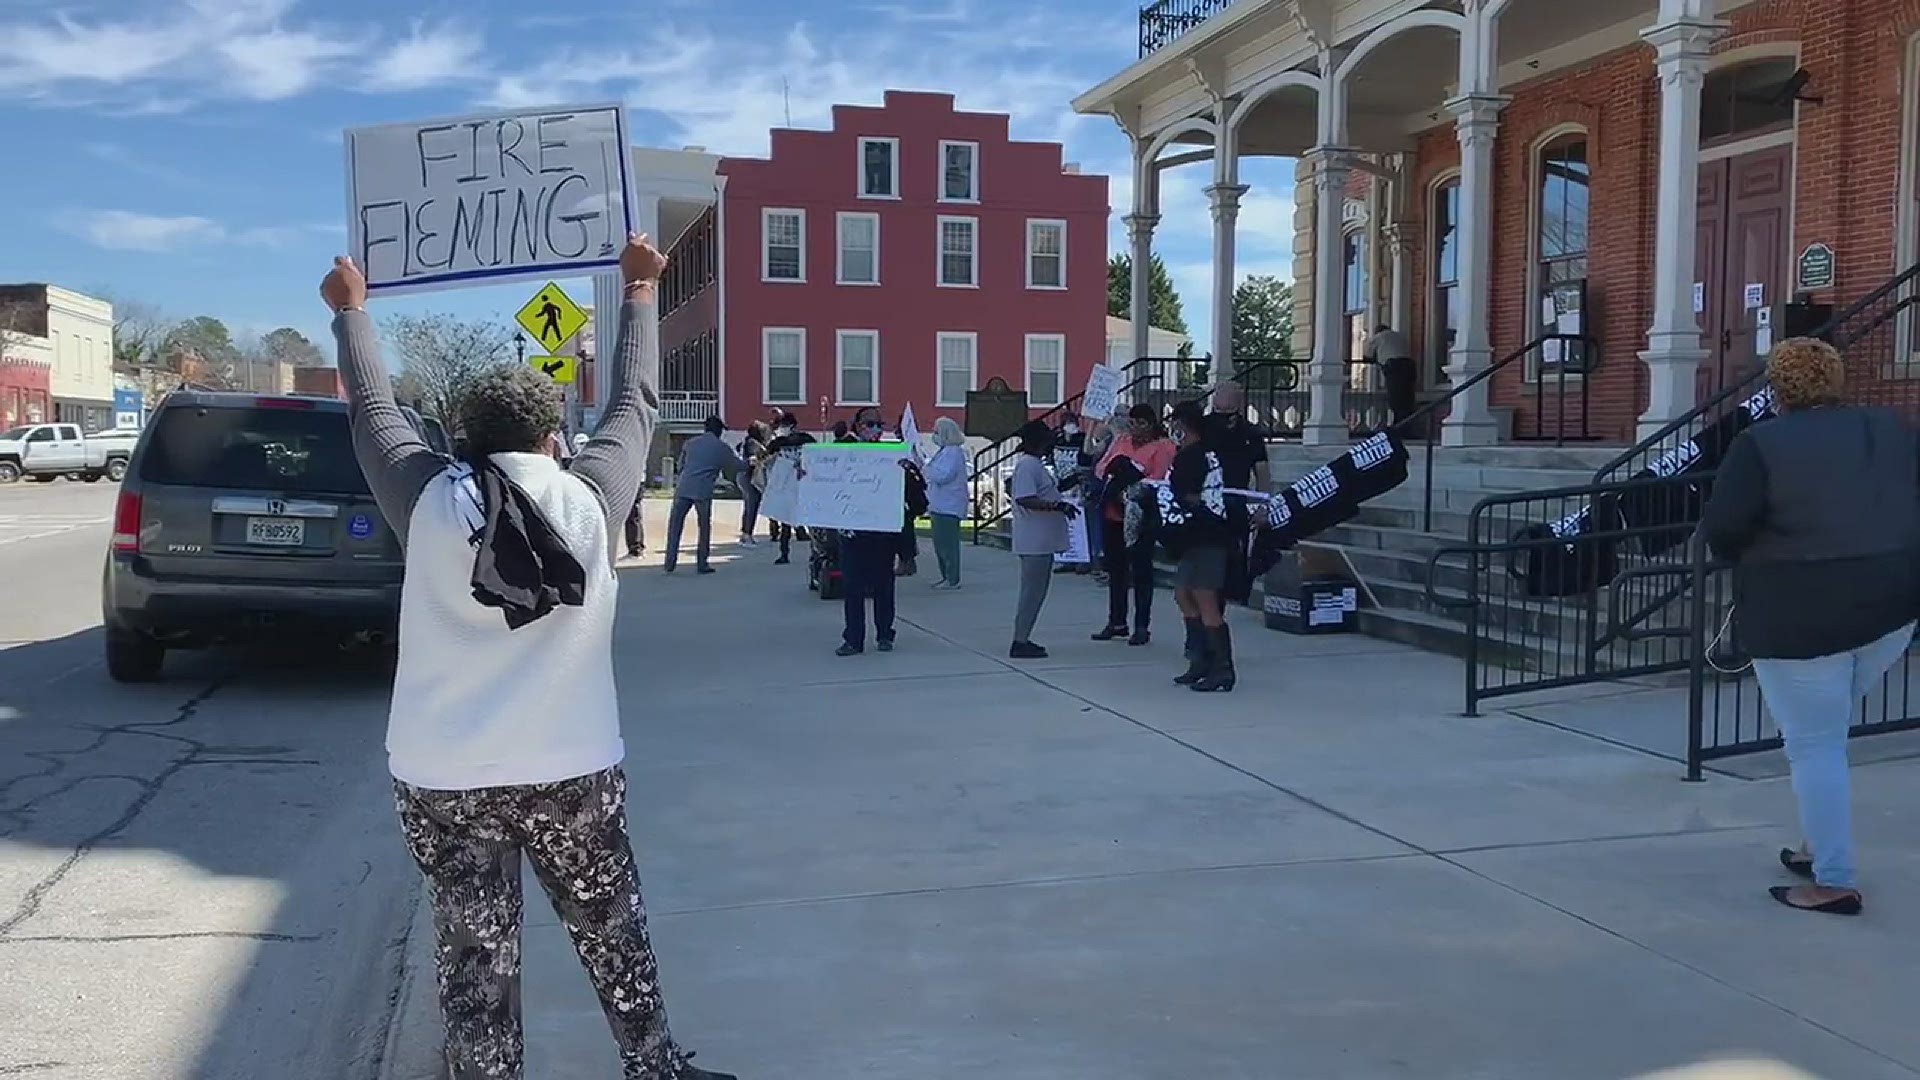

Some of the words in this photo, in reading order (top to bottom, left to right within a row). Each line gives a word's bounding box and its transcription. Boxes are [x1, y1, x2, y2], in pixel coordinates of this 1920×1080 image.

[417, 115, 574, 188] FIRE
[1351, 440, 1394, 470] MATTER
[1297, 475, 1340, 508] MATTER
